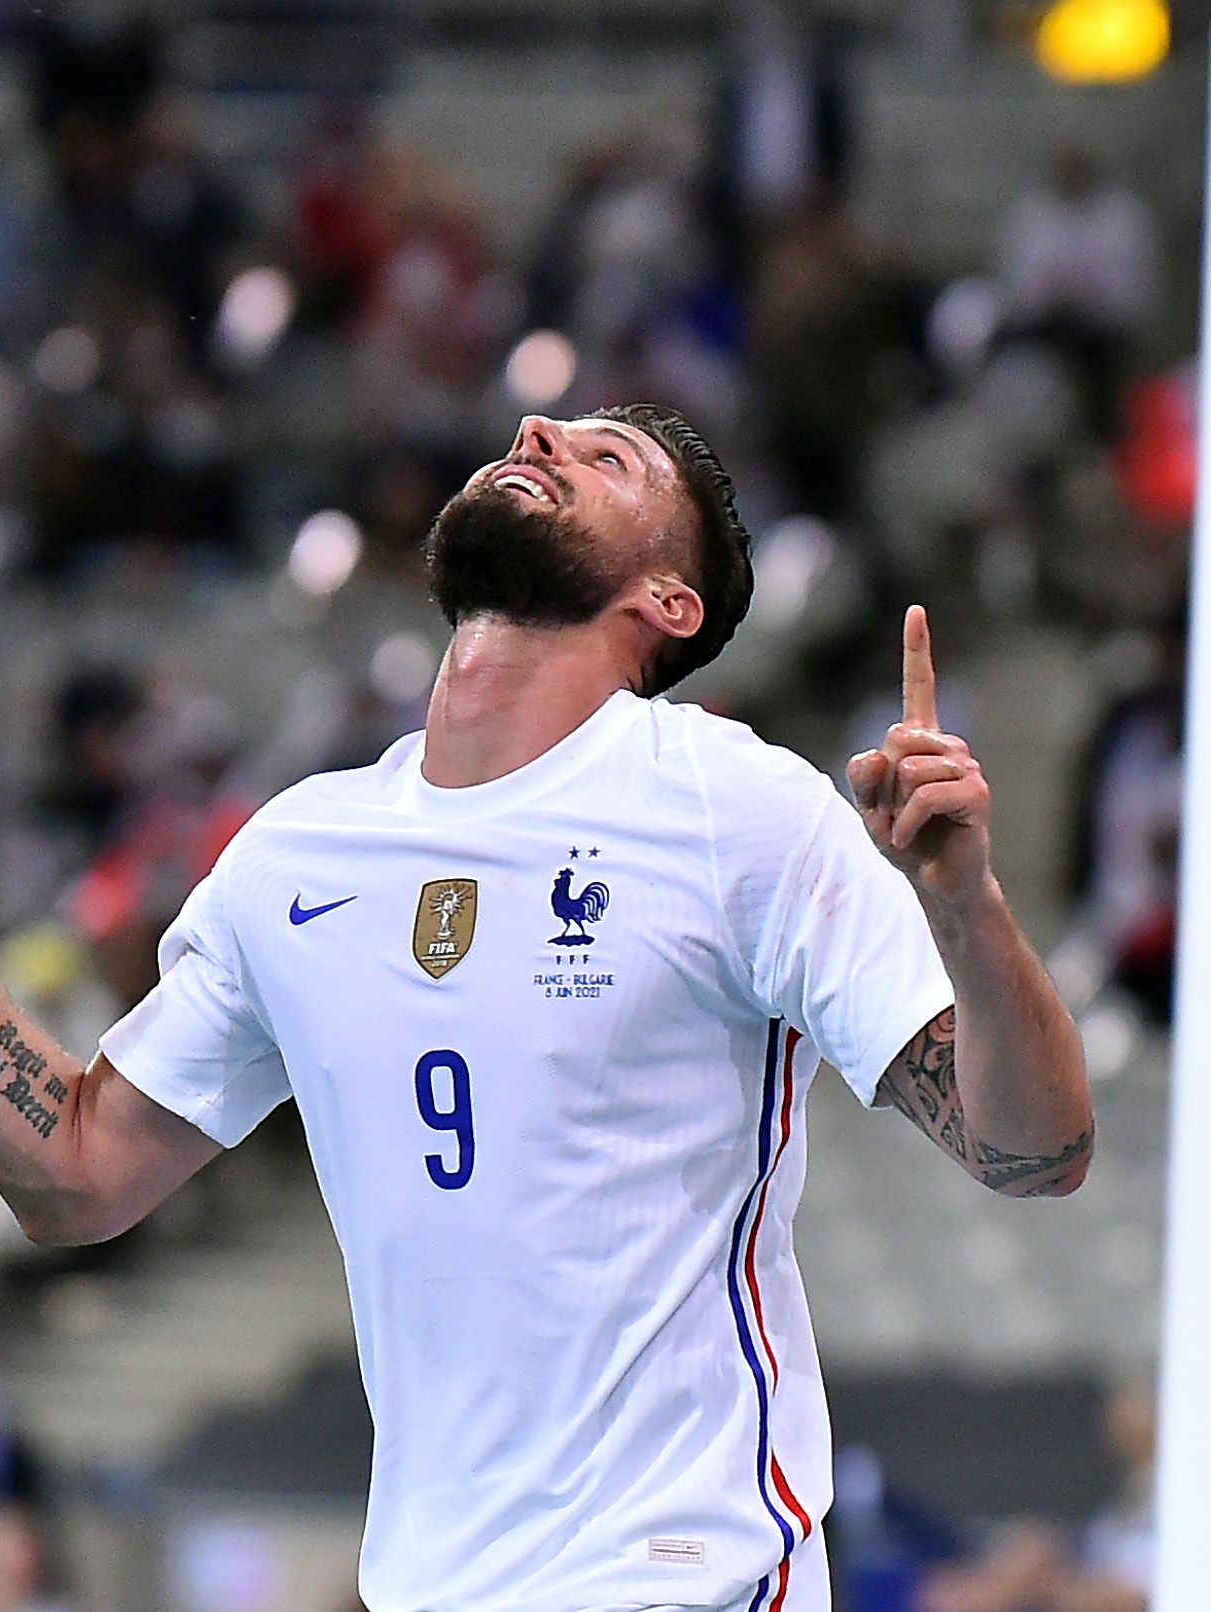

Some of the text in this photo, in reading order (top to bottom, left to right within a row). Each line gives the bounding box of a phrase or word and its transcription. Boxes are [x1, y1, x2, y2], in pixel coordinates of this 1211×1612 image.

[428, 942, 456, 955] FIFA
[533, 974, 564, 986] FRANCE
[573, 974, 614, 986] BULGARIE
[545, 986, 601, 998] 8 JUIN 2021
[415, 1049, 475, 1190] 9
